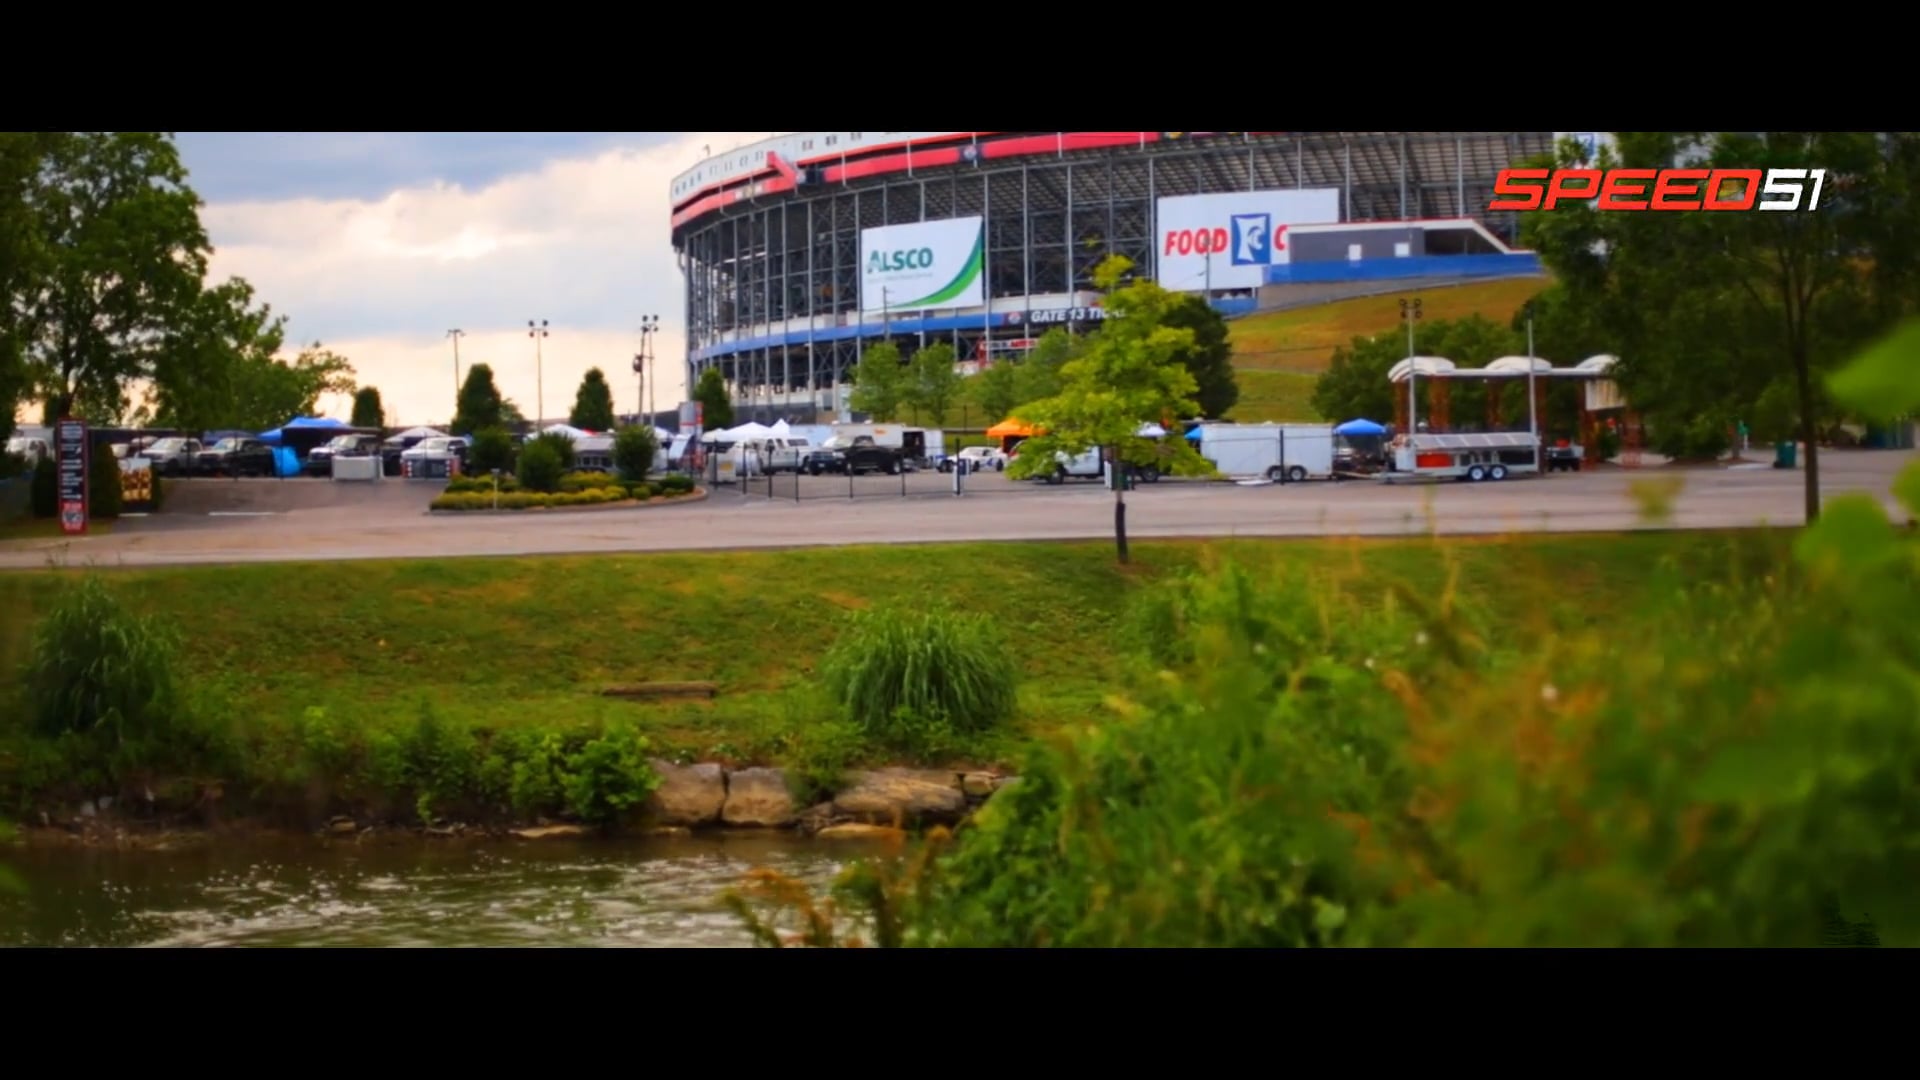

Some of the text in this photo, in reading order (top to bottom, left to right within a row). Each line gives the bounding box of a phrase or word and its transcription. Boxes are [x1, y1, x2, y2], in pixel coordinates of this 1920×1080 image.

[1164, 227, 1228, 256] FOOD
[866, 247, 933, 274] ALSCO
[1031, 310, 1066, 323] GATE
[1069, 308, 1085, 320] 13
